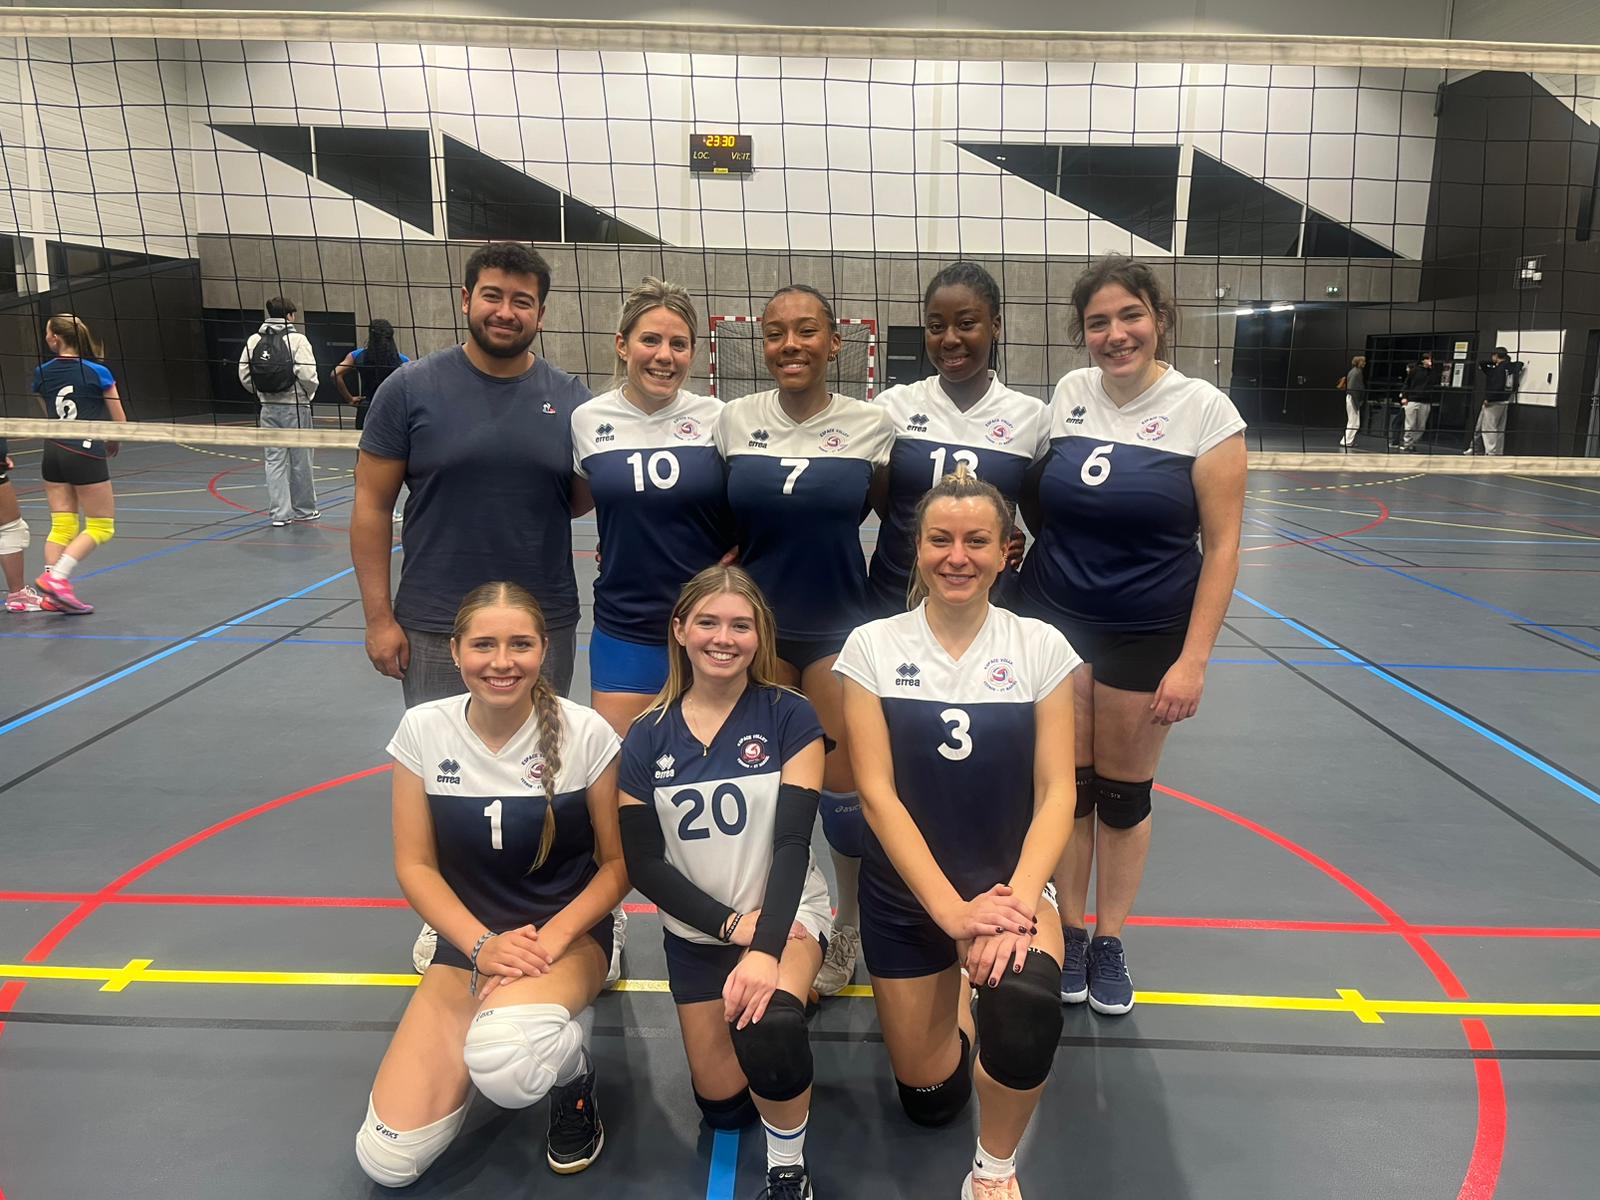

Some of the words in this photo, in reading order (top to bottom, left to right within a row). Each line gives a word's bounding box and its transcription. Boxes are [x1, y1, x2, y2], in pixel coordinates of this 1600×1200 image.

[55, 385, 78, 420] 6
[907, 424, 928, 433] errea
[626, 450, 680, 492] 10
[780, 458, 810, 495] 7
[930, 447, 979, 489] 13
[1080, 443, 1115, 486] 6
[895, 678, 920, 687] errea
[937, 708, 973, 761] 3
[437, 775, 461, 785] errea
[655, 768, 675, 779] errea
[484, 799, 503, 850] 1
[670, 782, 748, 841] 20
